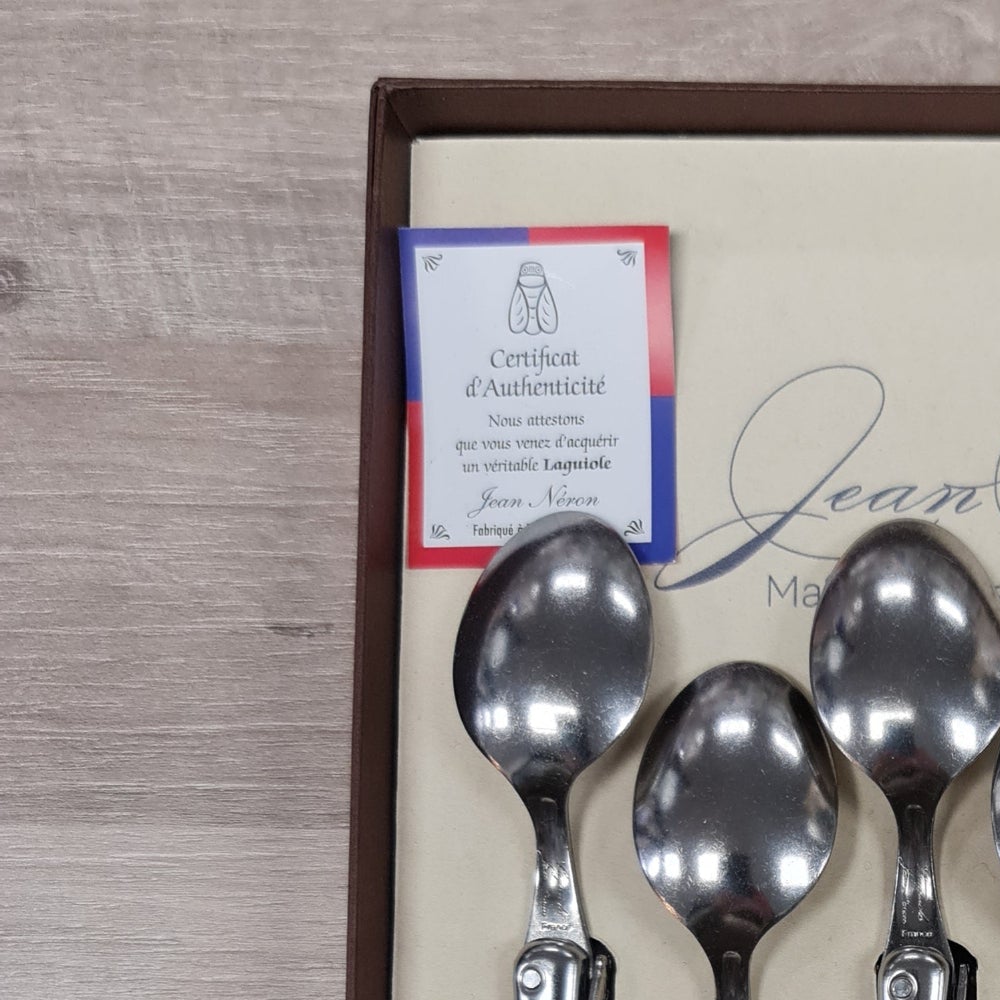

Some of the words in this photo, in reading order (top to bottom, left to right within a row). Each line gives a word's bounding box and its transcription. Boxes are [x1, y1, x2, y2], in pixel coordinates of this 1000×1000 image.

[490, 346, 580, 376] Certificat
[466, 374, 607, 398] d'Authenticité
[488, 414, 522, 428] Nous
[527, 414, 585, 427] attestons
[456, 441, 478, 456] que
[482, 440, 511, 451] vous
[516, 439, 551, 450] venez
[555, 434, 619, 453] d'acquérir
[462, 463, 479, 473] un
[484, 458, 539, 473] véritable
[543, 456, 612, 476] Laguiole
[655, 366, 983, 590] Jean
[467, 486, 523, 519] Jean
[528, 485, 600, 508] Néron
[473, 523, 514, 539] Fabriqué
